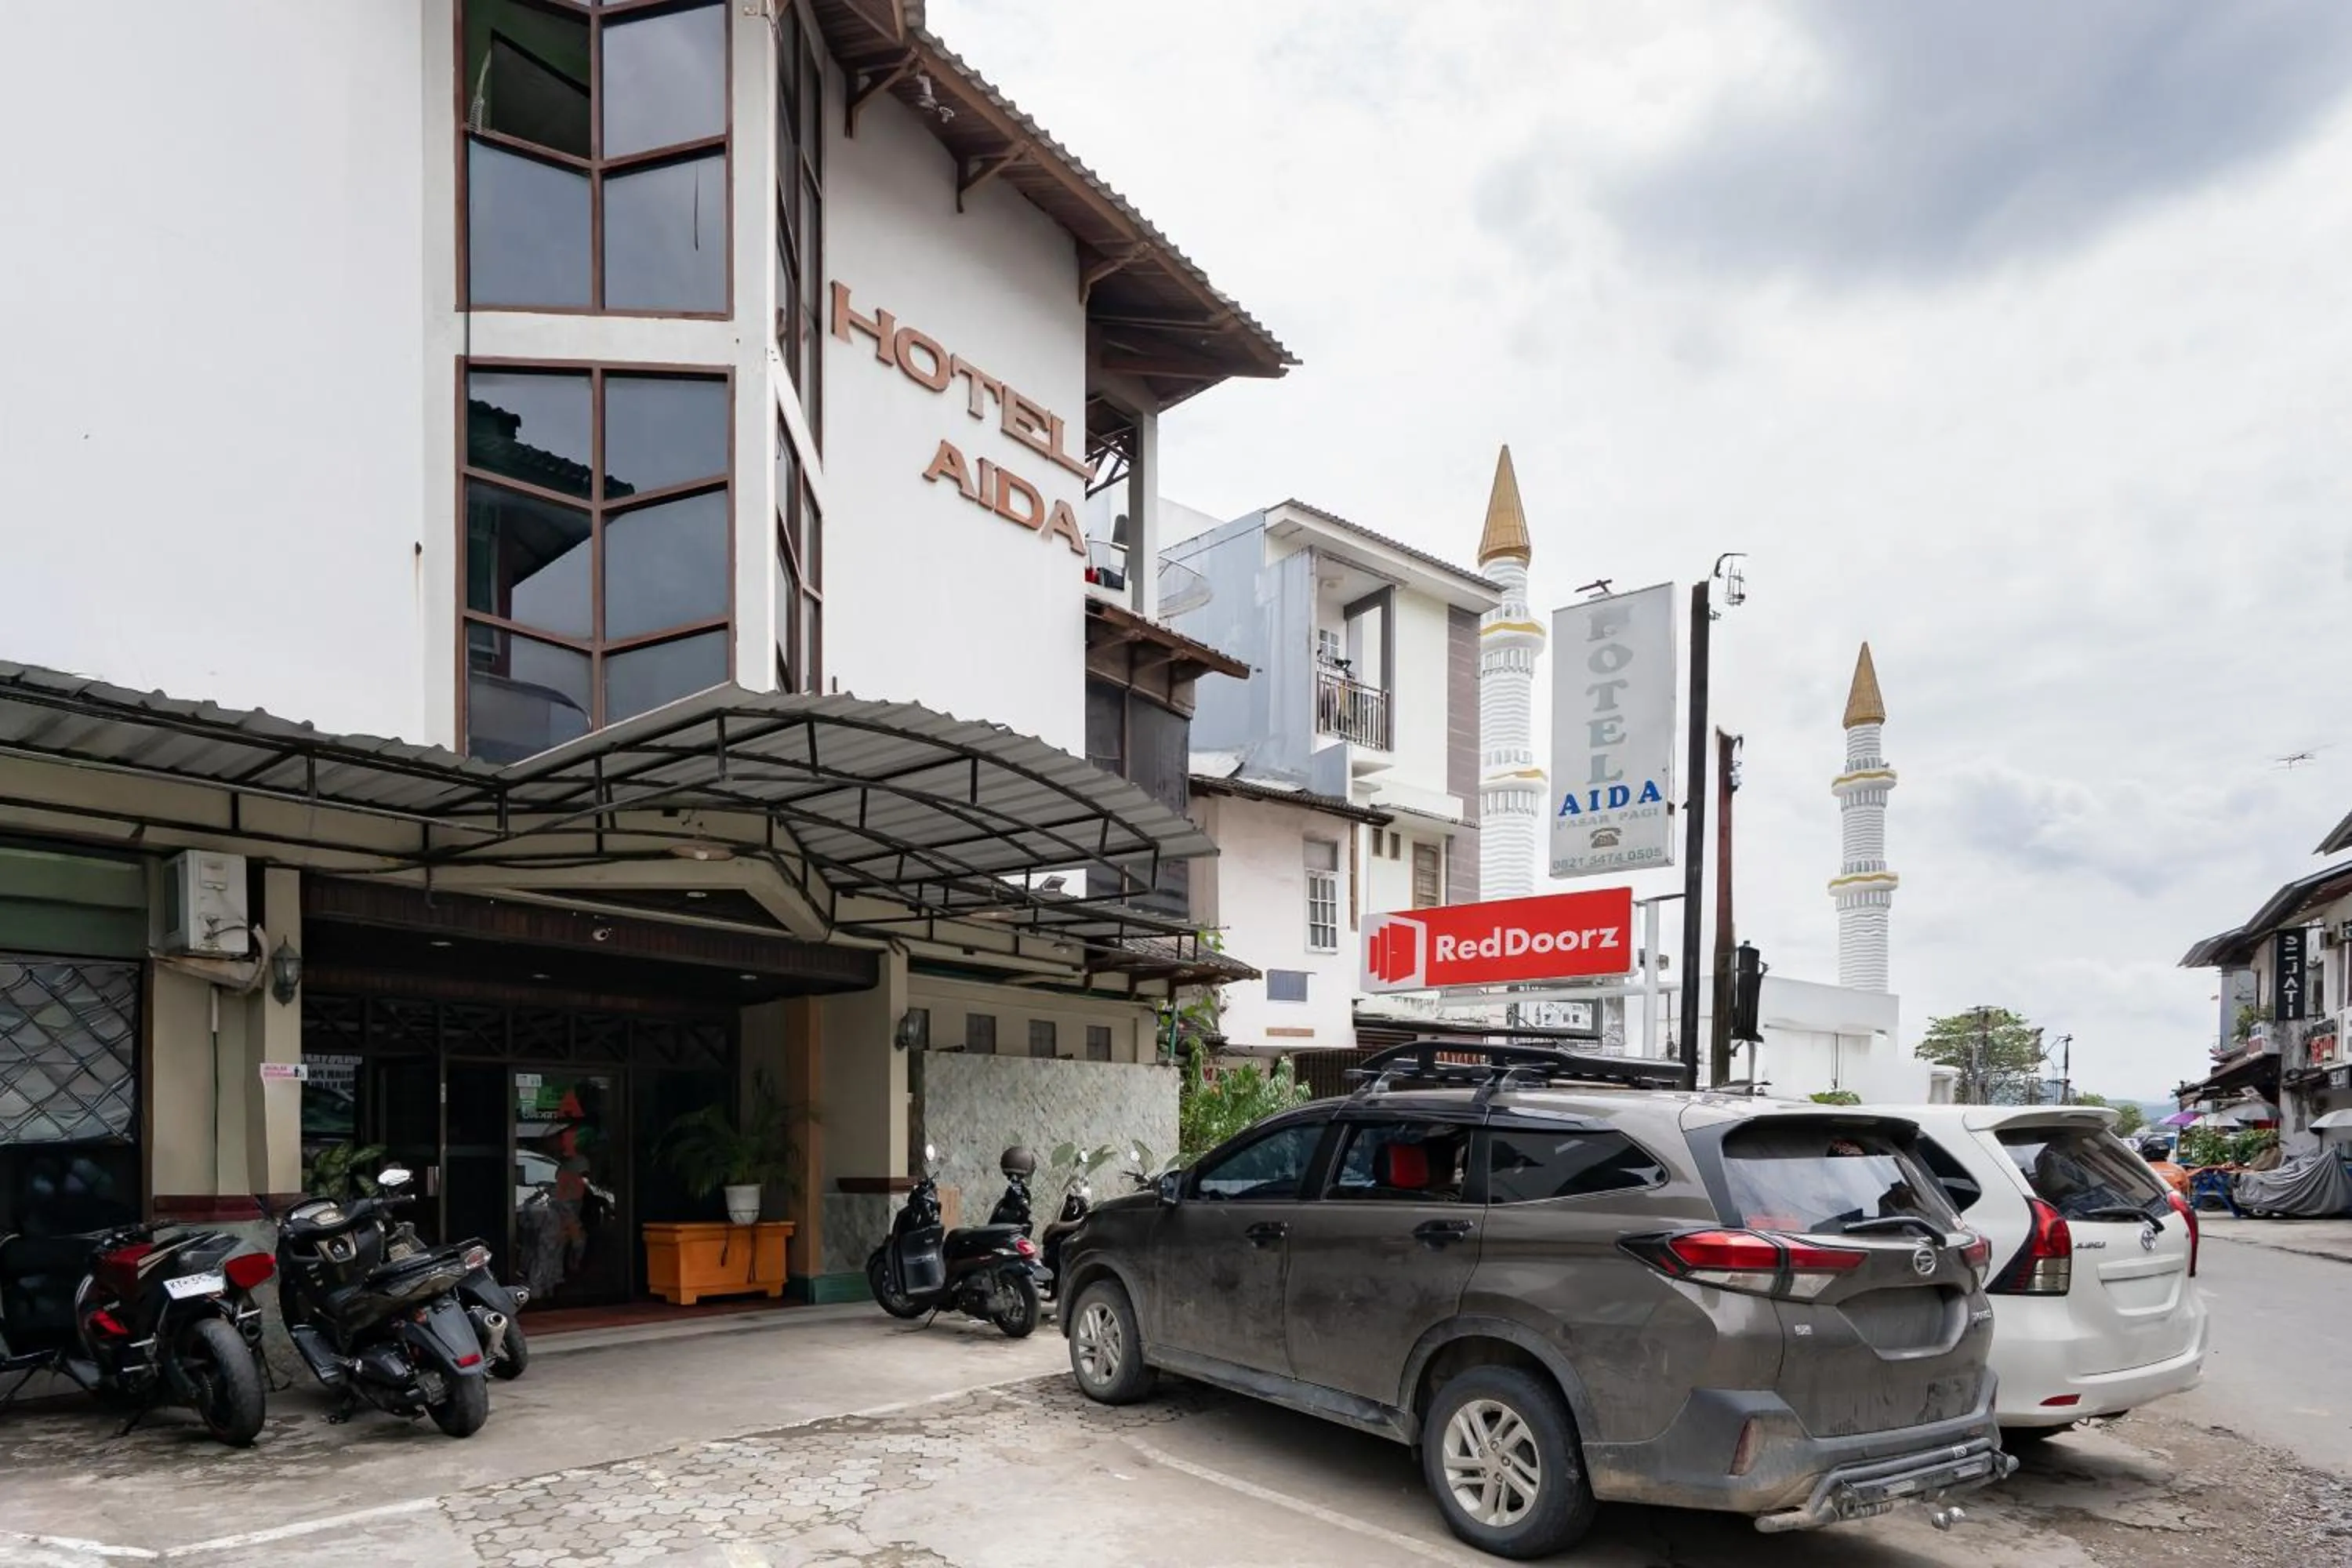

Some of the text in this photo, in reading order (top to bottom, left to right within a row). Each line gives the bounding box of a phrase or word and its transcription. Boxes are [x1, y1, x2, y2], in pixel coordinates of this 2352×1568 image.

[830, 280, 1097, 482] HOTEL
[922, 439, 1086, 555] AIDA
[1559, 779, 1662, 816] AIDA
[1436, 925, 1619, 963] RedDoorz
